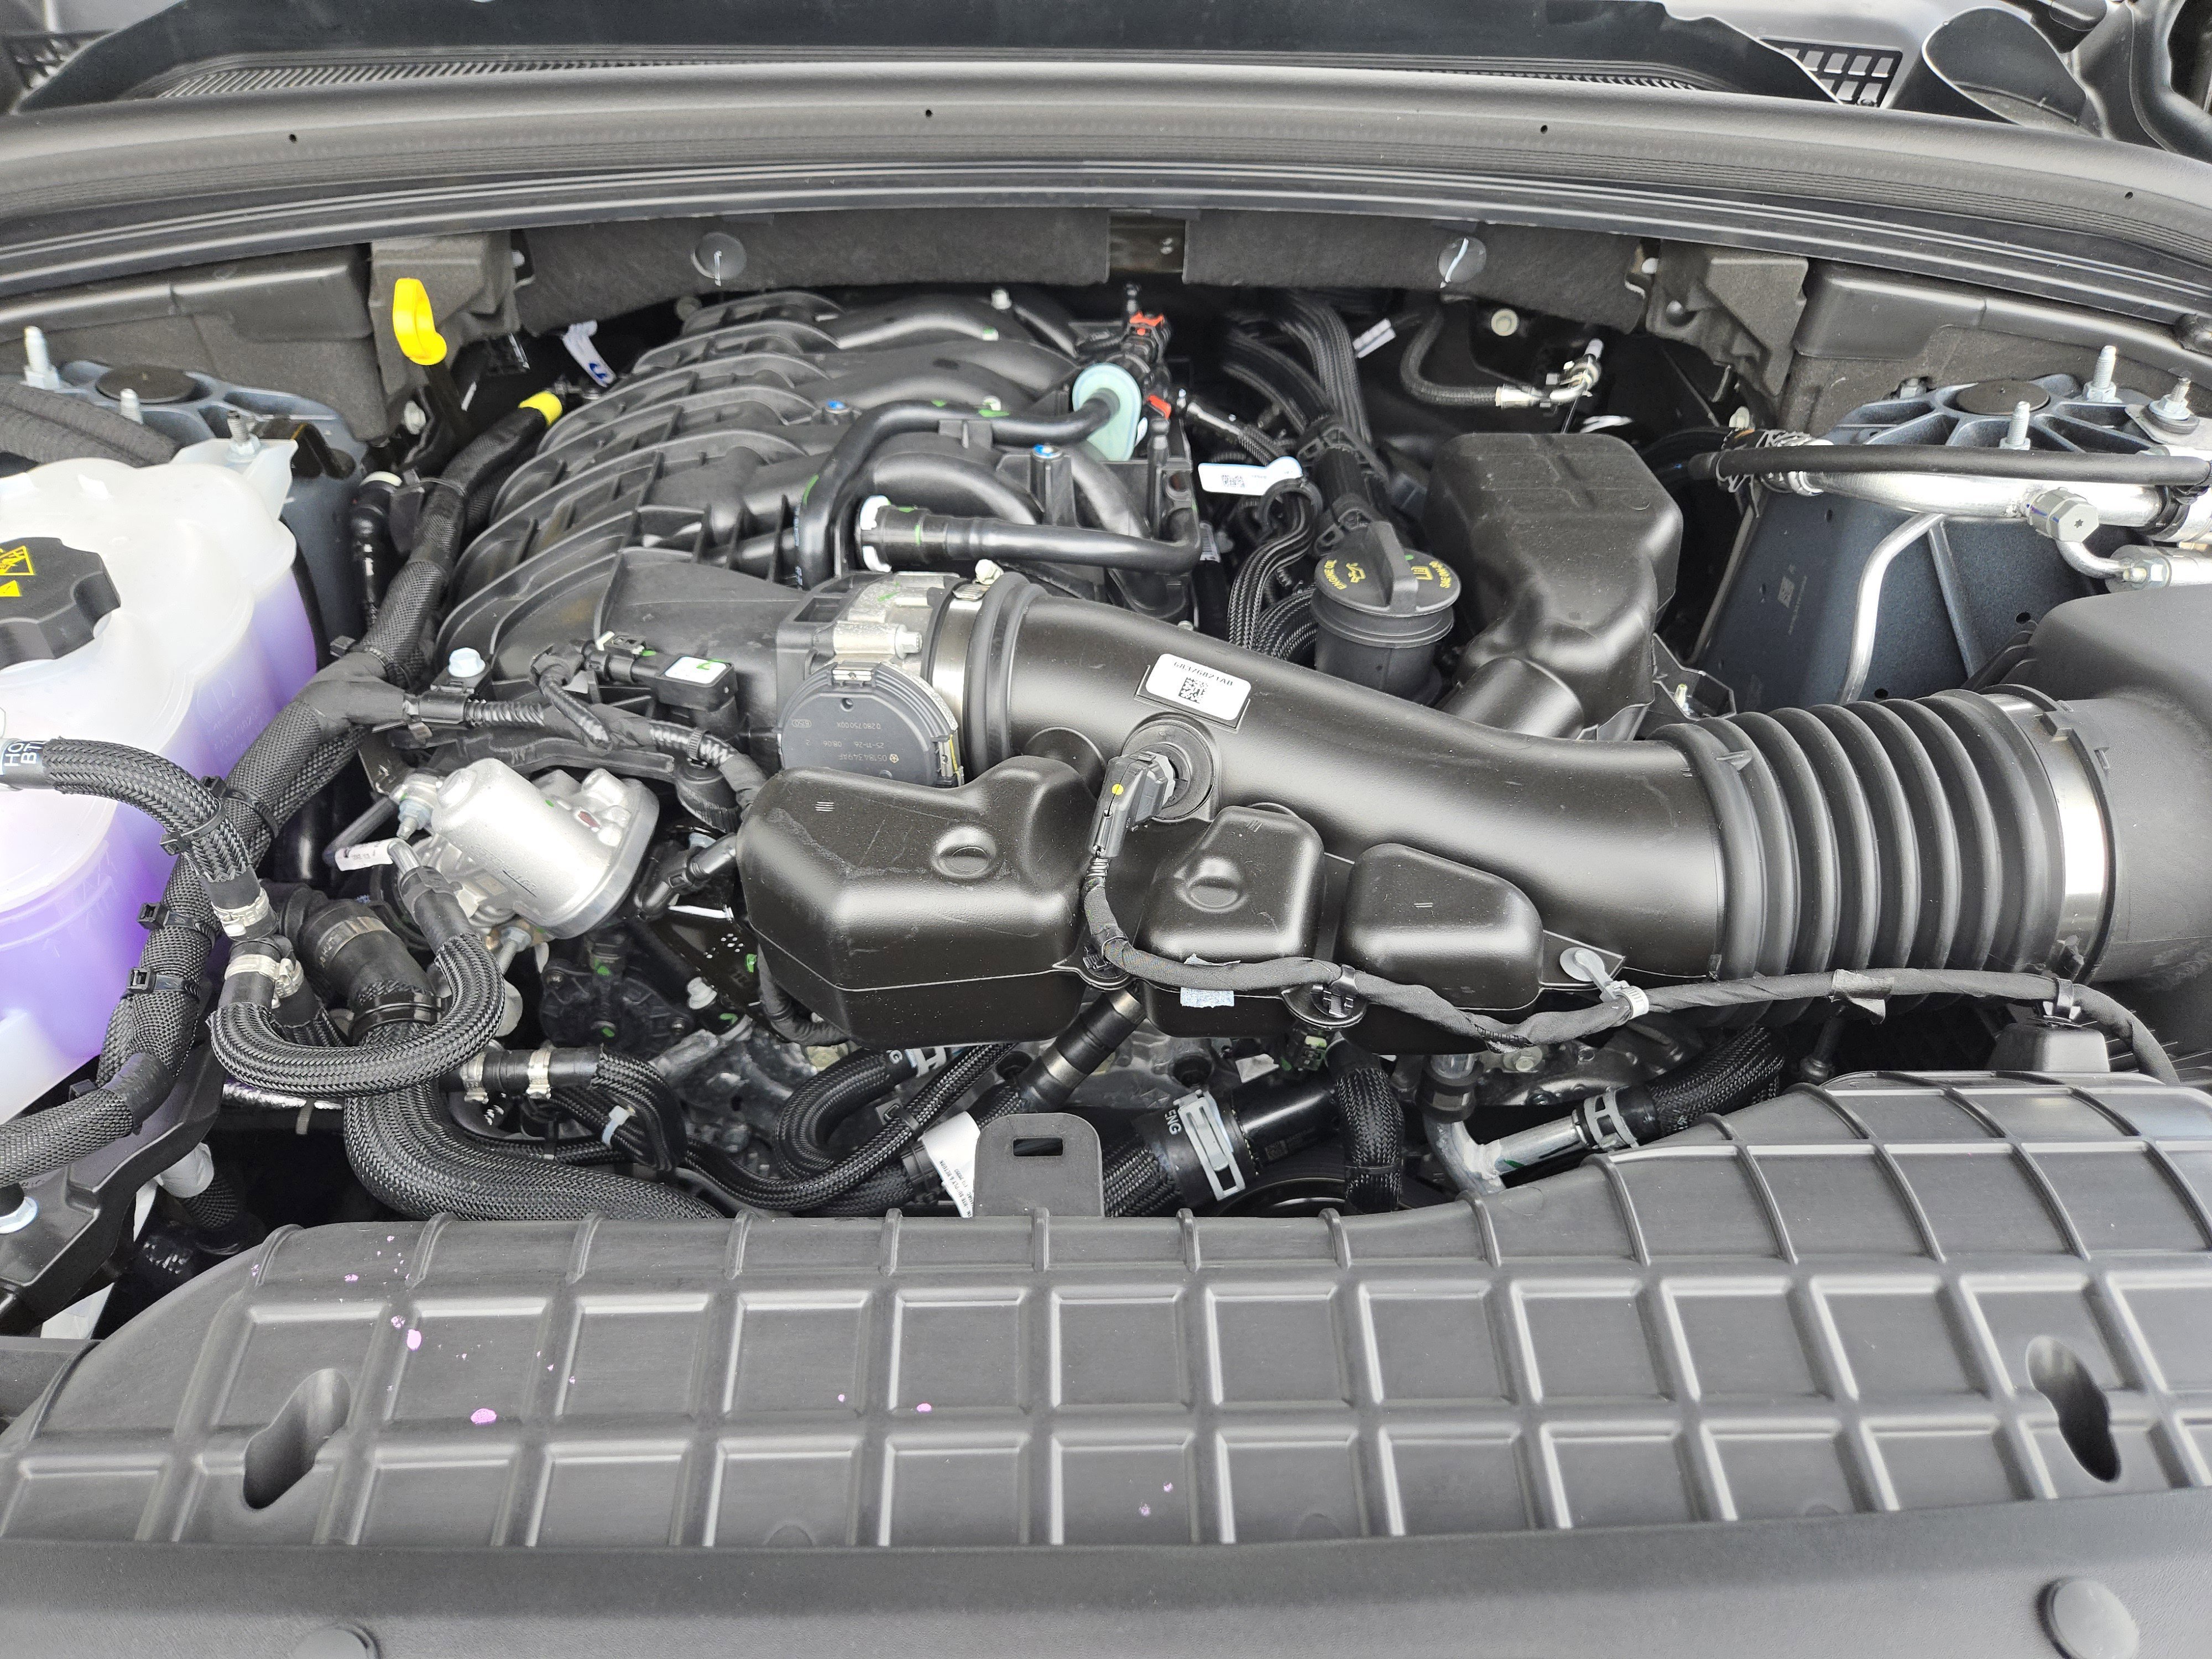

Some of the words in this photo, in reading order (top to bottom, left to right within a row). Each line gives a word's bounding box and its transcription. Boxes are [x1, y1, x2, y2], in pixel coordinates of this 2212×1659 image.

[1324, 559, 1337, 568] OIL
[1324, 568, 1347, 590] ENGINE
[1439, 576, 1452, 588] SAE
[839, 754, 888, 762] 05184349AF
[1164, 1109, 1182, 1135] ENG
[939, 1160, 952, 1177] RETURN
